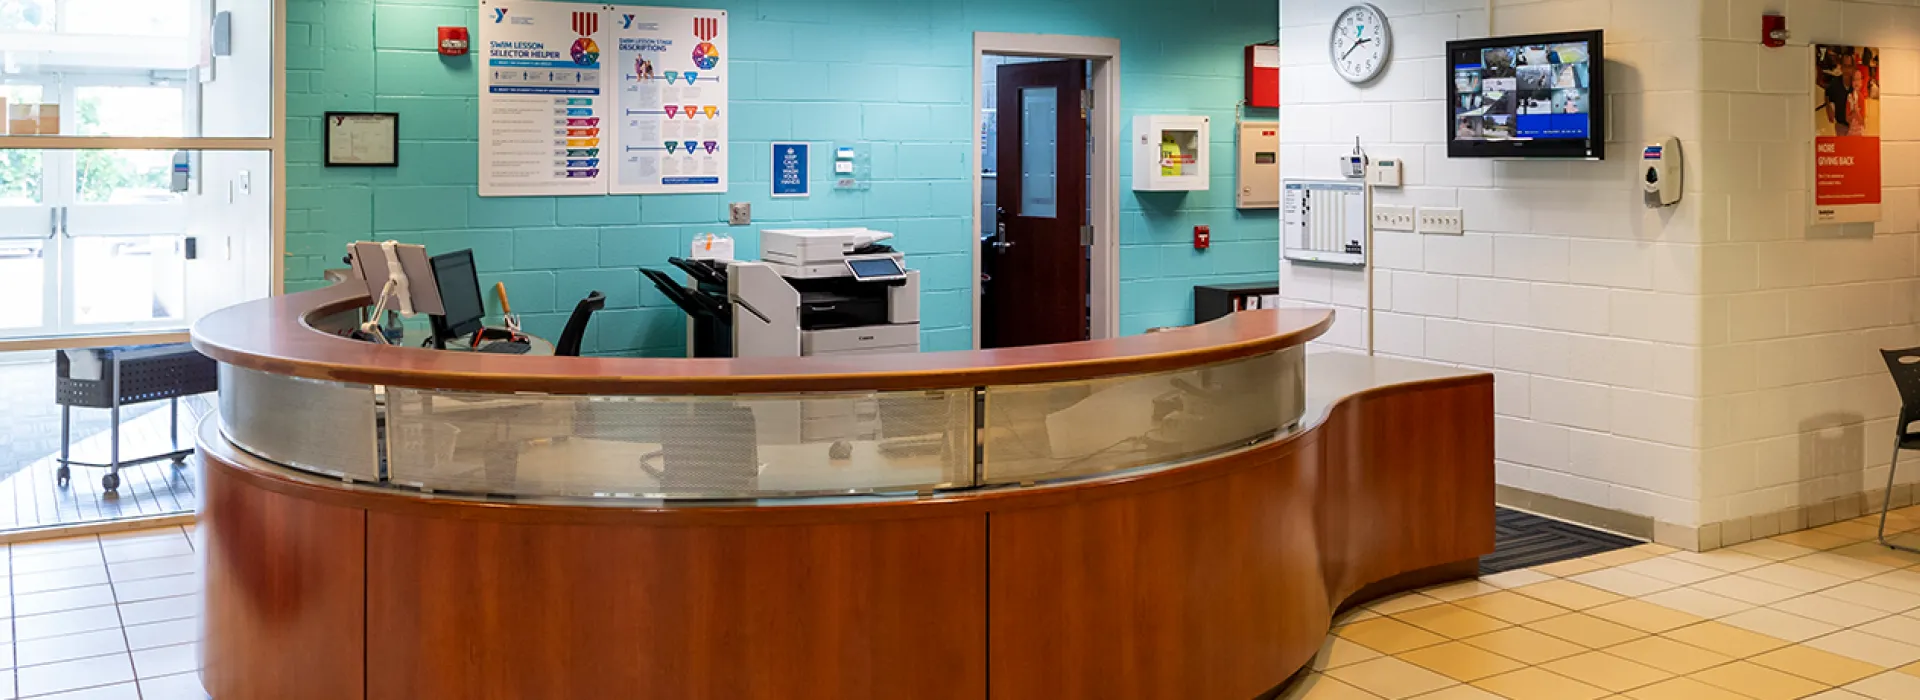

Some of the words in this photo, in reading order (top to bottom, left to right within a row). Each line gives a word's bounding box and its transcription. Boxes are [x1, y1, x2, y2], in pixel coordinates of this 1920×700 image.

[1374, 25, 1379, 35] 2
[489, 40, 512, 48] SWIM
[514, 41, 544, 49] LESSON
[1376, 37, 1381, 47] 3
[489, 49, 529, 58] SELECTOR
[531, 50, 560, 58] HELPER
[1347, 60, 1352, 69] 7
[1355, 63, 1361, 73] 6
[1366, 59, 1371, 69] 5
[1818, 143, 1836, 153] MORE
[1818, 156, 1839, 167] GIVING
[1839, 156, 1855, 166] BACK
